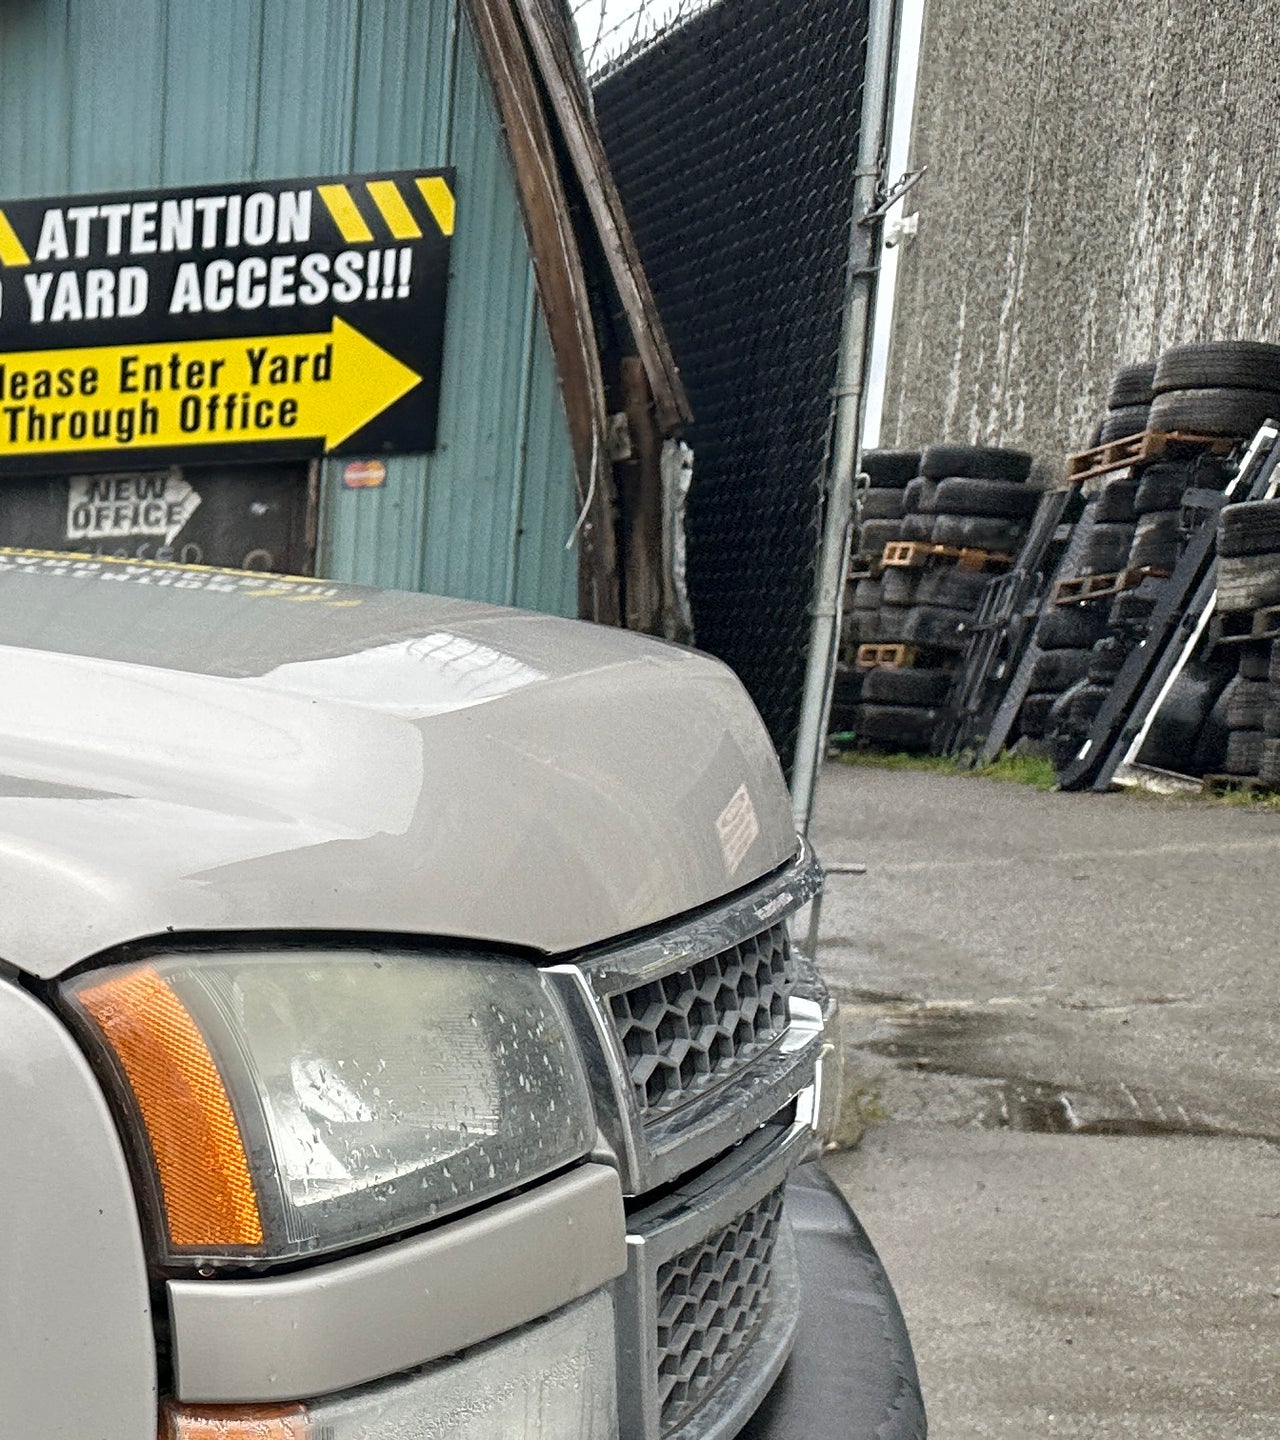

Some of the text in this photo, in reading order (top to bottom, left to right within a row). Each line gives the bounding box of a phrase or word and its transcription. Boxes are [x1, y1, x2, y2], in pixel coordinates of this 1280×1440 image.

[35, 189, 313, 261] ATTENTION
[25, 265, 149, 323] YARD
[168, 247, 412, 314] ACCESS!!!
[119, 354, 225, 393] Enter
[245, 342, 333, 386] Yard
[2, 392, 299, 444] Through Office
[88, 476, 168, 502] NEW
[73, 501, 184, 531] OFFICE
